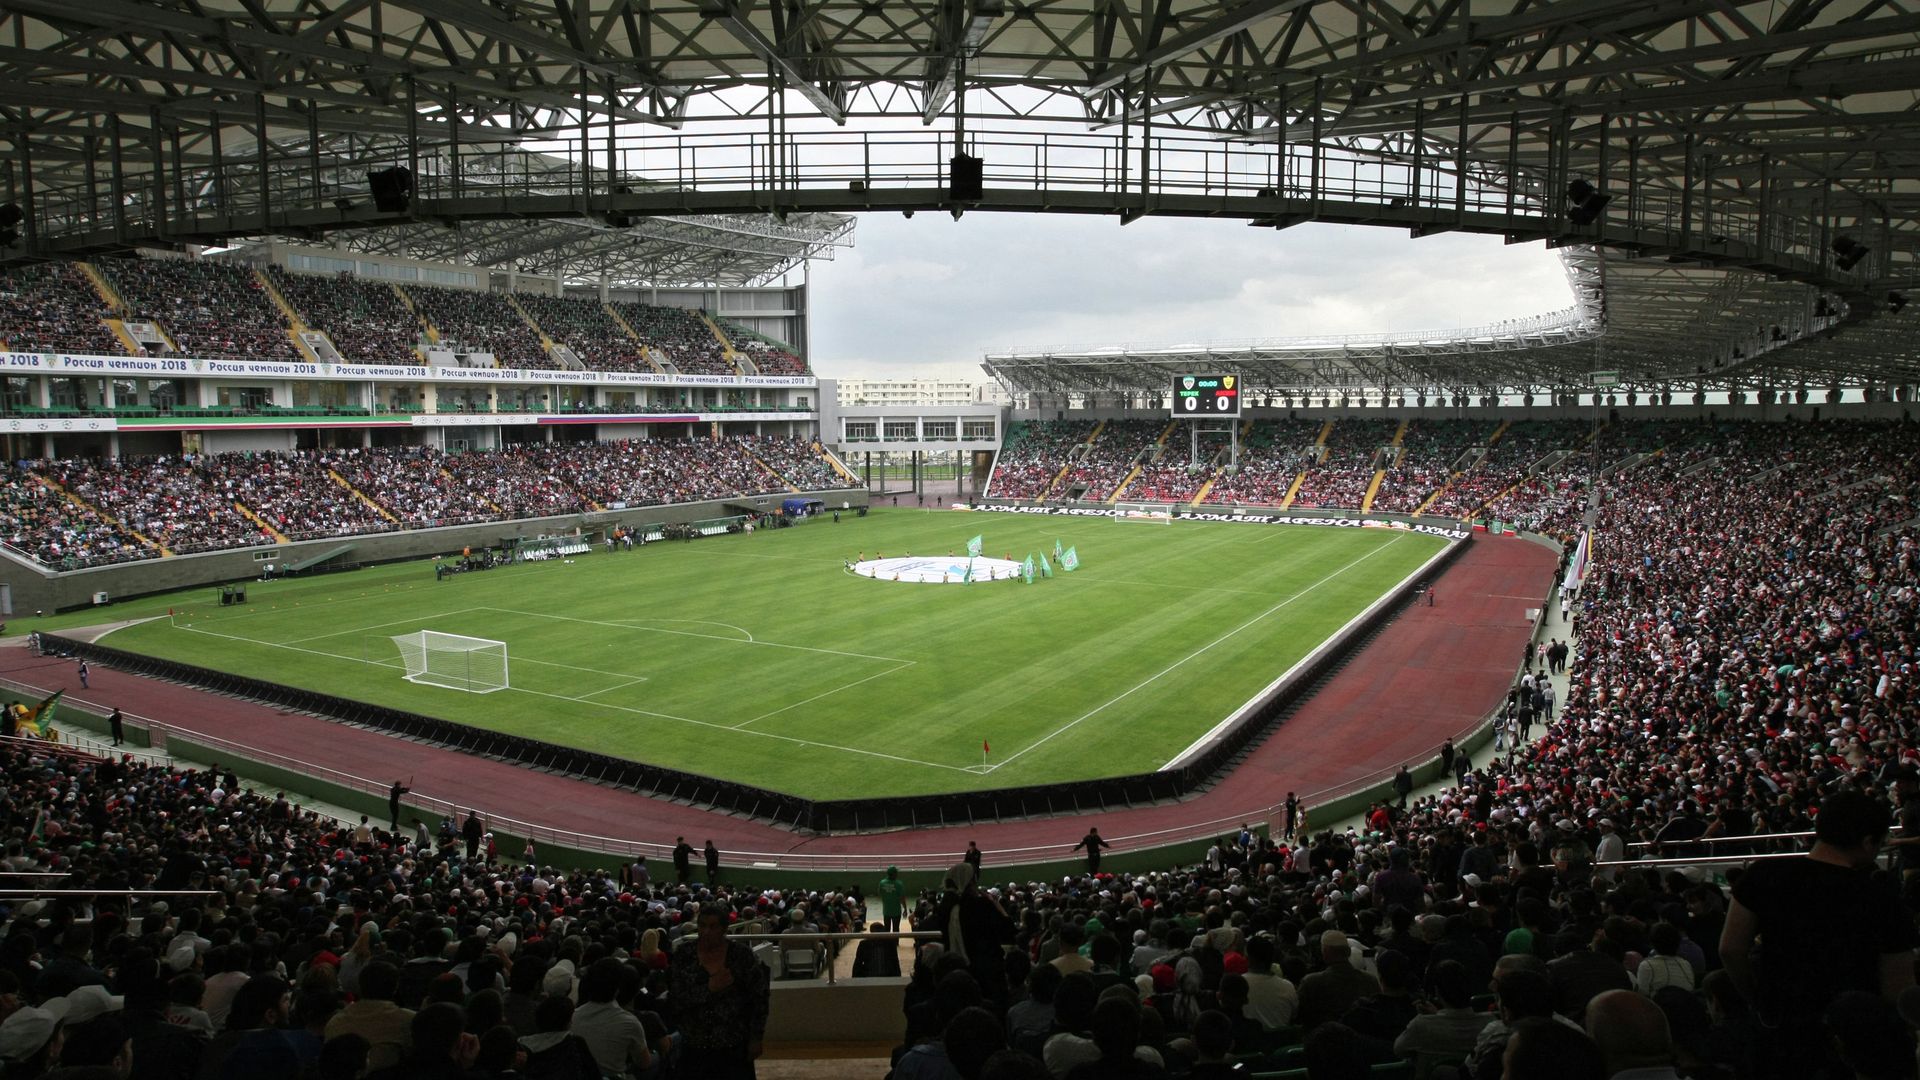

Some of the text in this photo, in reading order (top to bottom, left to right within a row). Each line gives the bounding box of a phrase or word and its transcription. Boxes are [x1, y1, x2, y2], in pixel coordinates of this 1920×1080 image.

[10, 354, 39, 366] 2018
[64, 356, 187, 371] Россия чемпион 2018
[209, 362, 316, 374] Россия чемпион 2018
[336, 366, 366, 375] Россия
[406, 367, 426, 376] 2018
[501, 370, 518, 379] 2018
[1185, 396, 1197, 411] 0
[1217, 396, 1229, 411] 0
